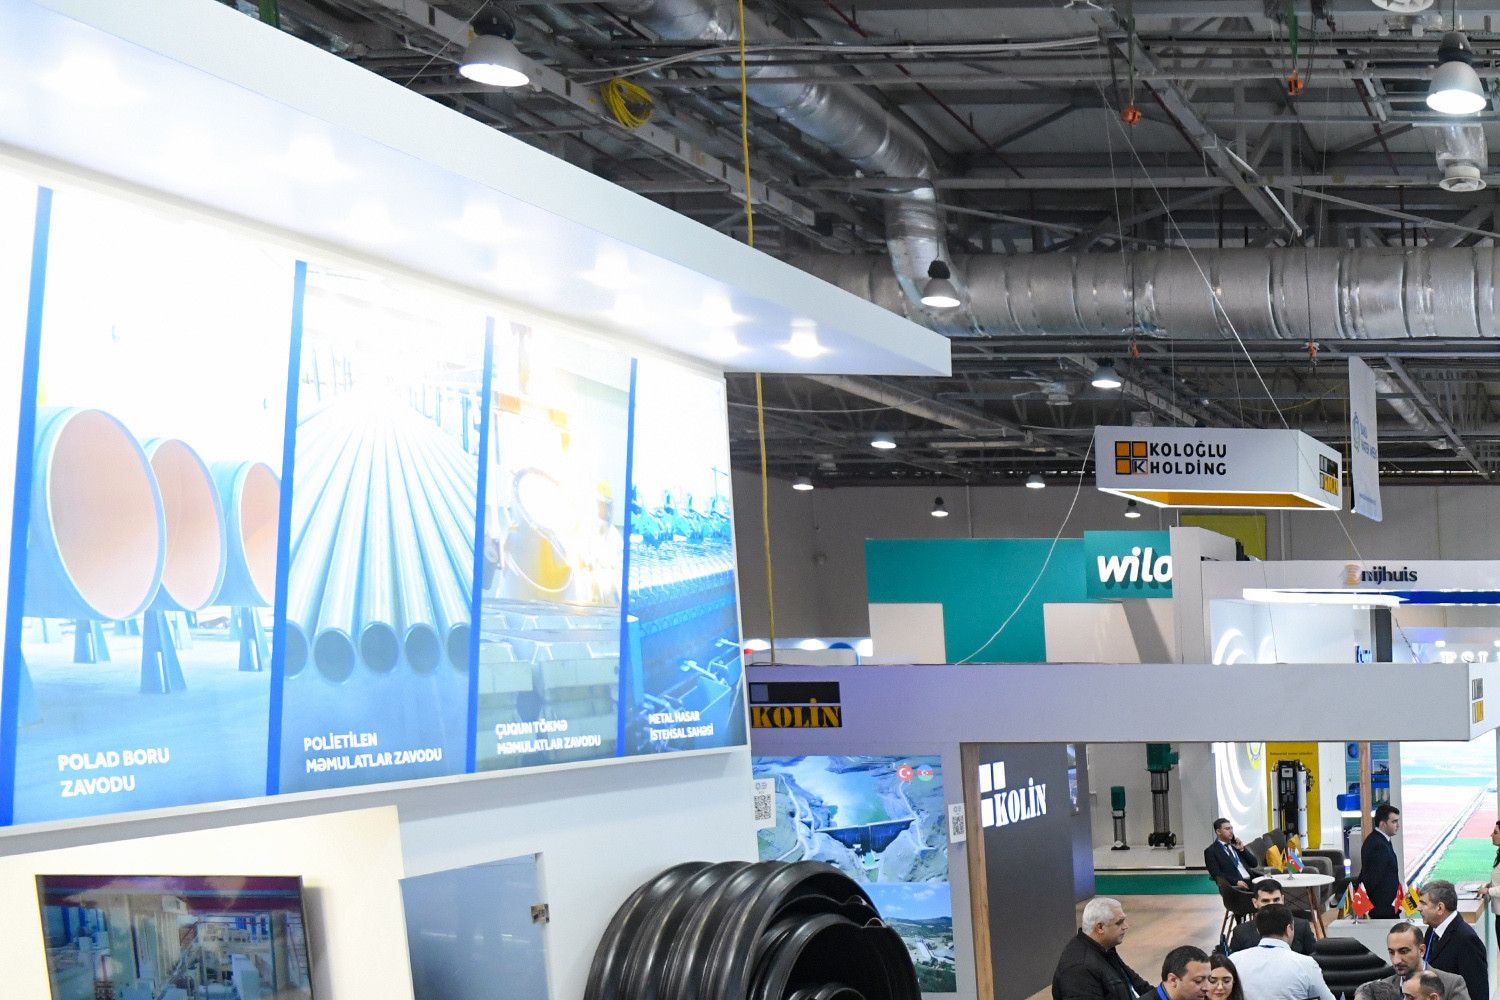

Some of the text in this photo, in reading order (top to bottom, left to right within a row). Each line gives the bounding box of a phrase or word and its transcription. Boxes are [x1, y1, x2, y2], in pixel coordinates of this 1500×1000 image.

[1150, 440, 1227, 458] KOLOĞLU
[1150, 460, 1227, 475] HOLDİNG
[1097, 546, 1173, 583] wilo
[1361, 566, 1418, 586] nijhuis
[649, 712, 675, 725] METAL
[751, 698, 841, 728] KOLİN
[496, 718, 568, 739] ÇUQUN TÖKMƏ
[304, 731, 378, 751] POLİETİLEN
[497, 735, 601, 755] MƏMULATLAR ZAVODU
[58, 748, 170, 772] POLAD BORU
[306, 748, 442, 773] MƏMULATLAR ZAVODU
[61, 775, 136, 797] ZAVODU
[994, 777, 1047, 827] KOLİN
